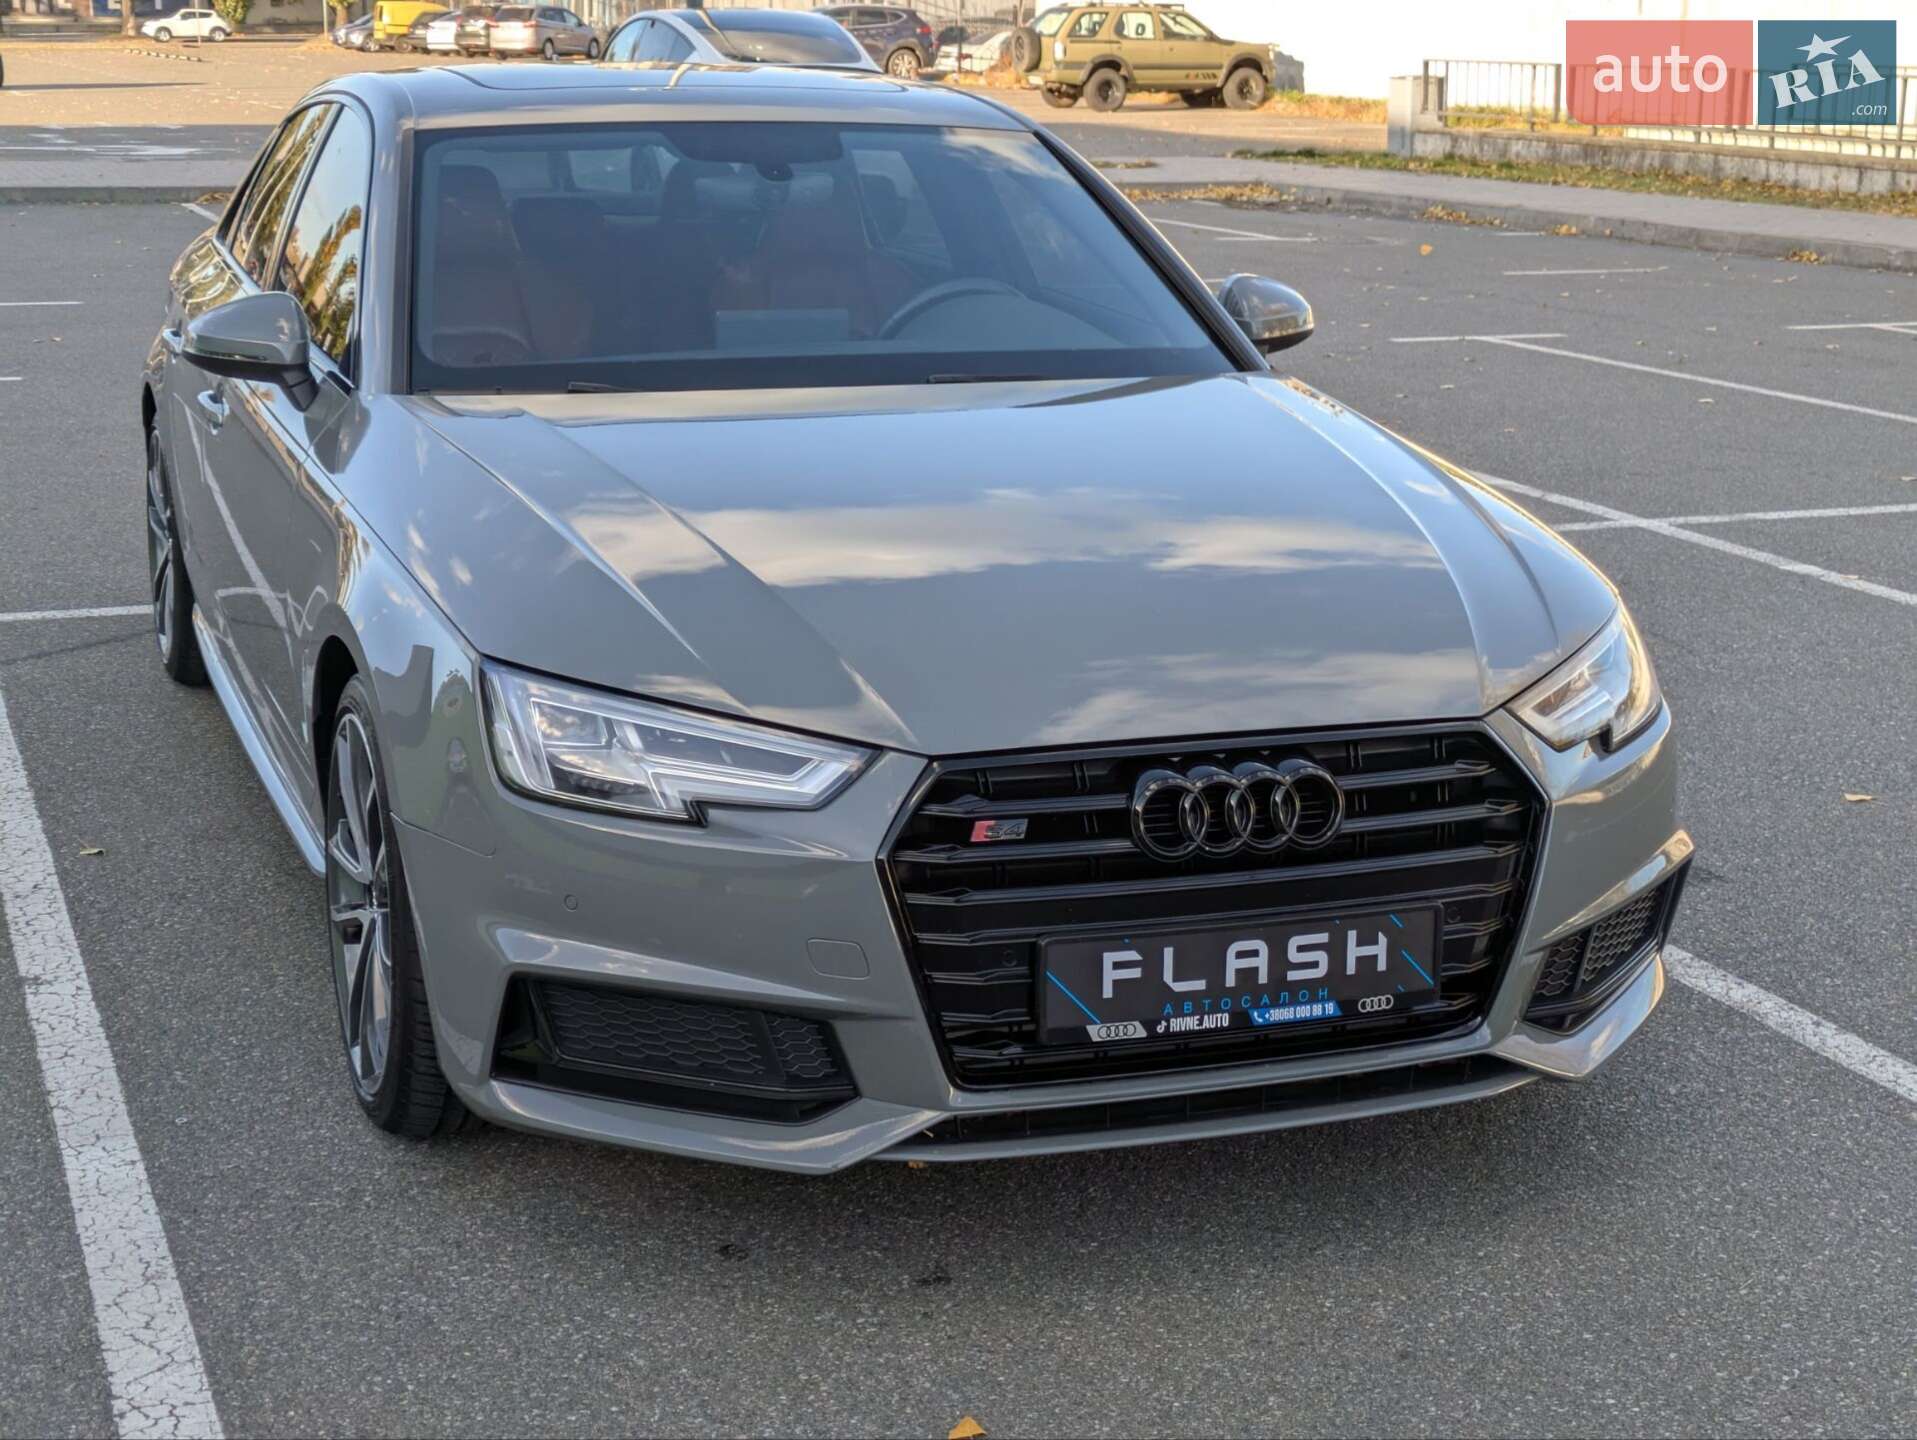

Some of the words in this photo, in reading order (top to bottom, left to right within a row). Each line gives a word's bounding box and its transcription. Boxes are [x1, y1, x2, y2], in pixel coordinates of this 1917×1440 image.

[1102, 930, 1388, 999] FLASH
[1163, 987, 1329, 1017] АВТОСАЛОН
[1169, 1012, 1230, 1033] RIVNE.AUTO
